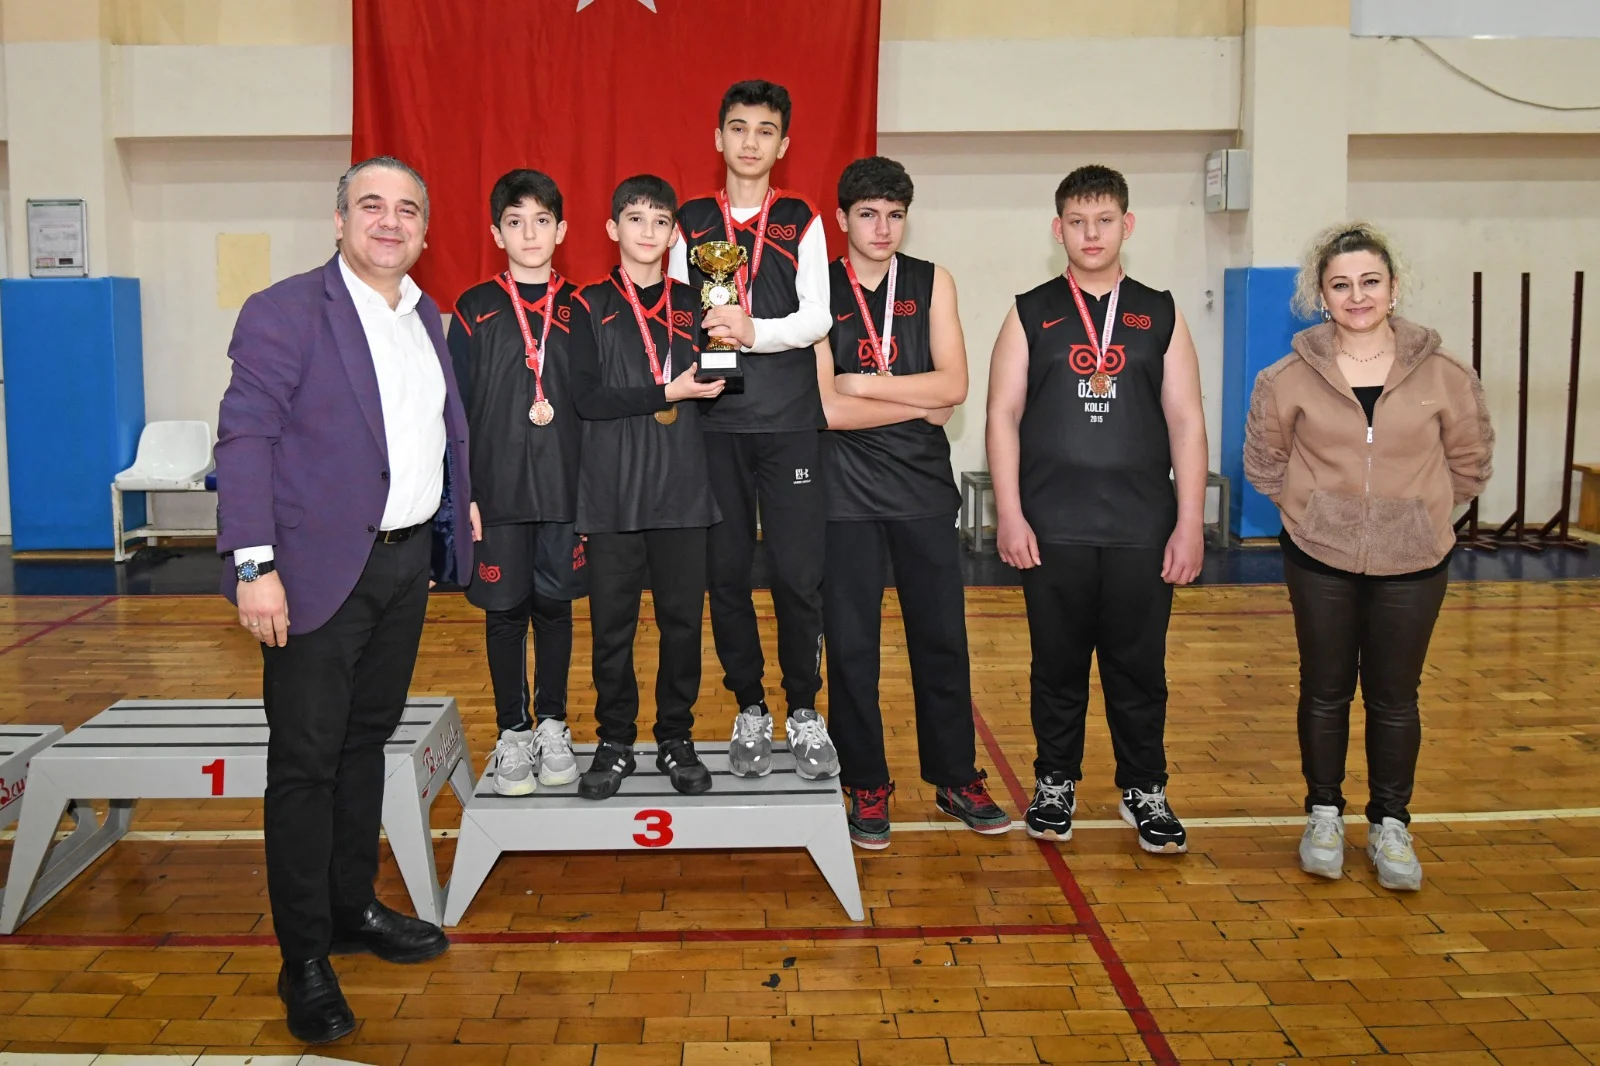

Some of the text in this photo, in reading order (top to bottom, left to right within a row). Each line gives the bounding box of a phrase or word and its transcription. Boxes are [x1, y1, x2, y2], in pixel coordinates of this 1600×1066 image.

[1077, 379, 1117, 399] ÖZN
[1084, 401, 1110, 413] KOLEJİ
[1090, 415, 1104, 423] 2015
[201, 758, 225, 796] 1
[632, 809, 674, 848] 3
